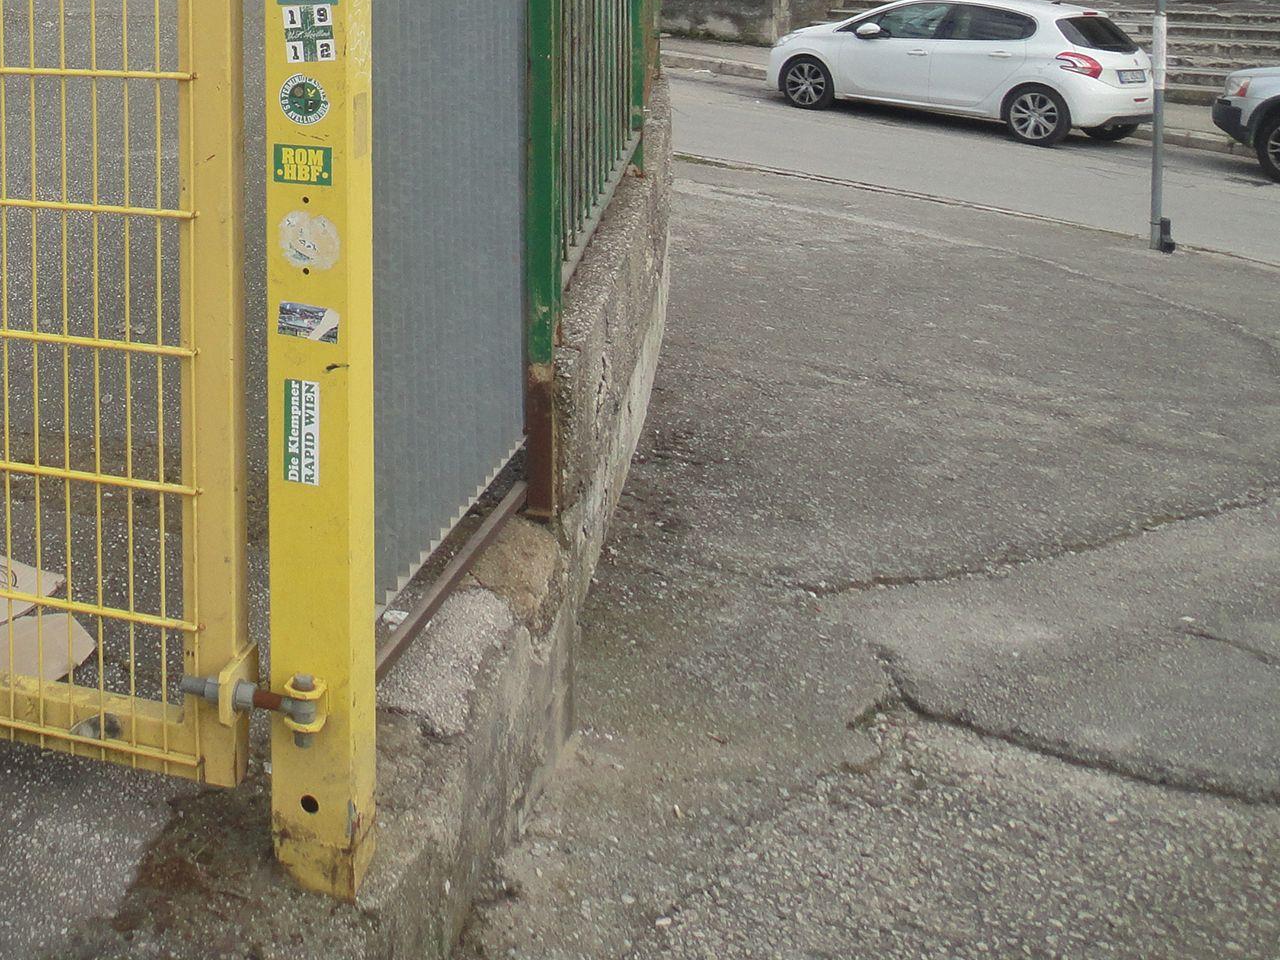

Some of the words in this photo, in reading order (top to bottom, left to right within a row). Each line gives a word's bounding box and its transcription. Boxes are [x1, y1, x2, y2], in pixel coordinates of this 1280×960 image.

[288, 9, 297, 24] 1
[316, 7, 328, 23] 9
[291, 44, 300, 60] 1
[319, 42, 331, 58] 2
[281, 147, 324, 166] ROM
[283, 163, 323, 182] HBF
[304, 382, 316, 426] WIEN
[288, 380, 302, 454] Klempner
[304, 431, 316, 484] RAPID
[288, 457, 301, 483] Die
